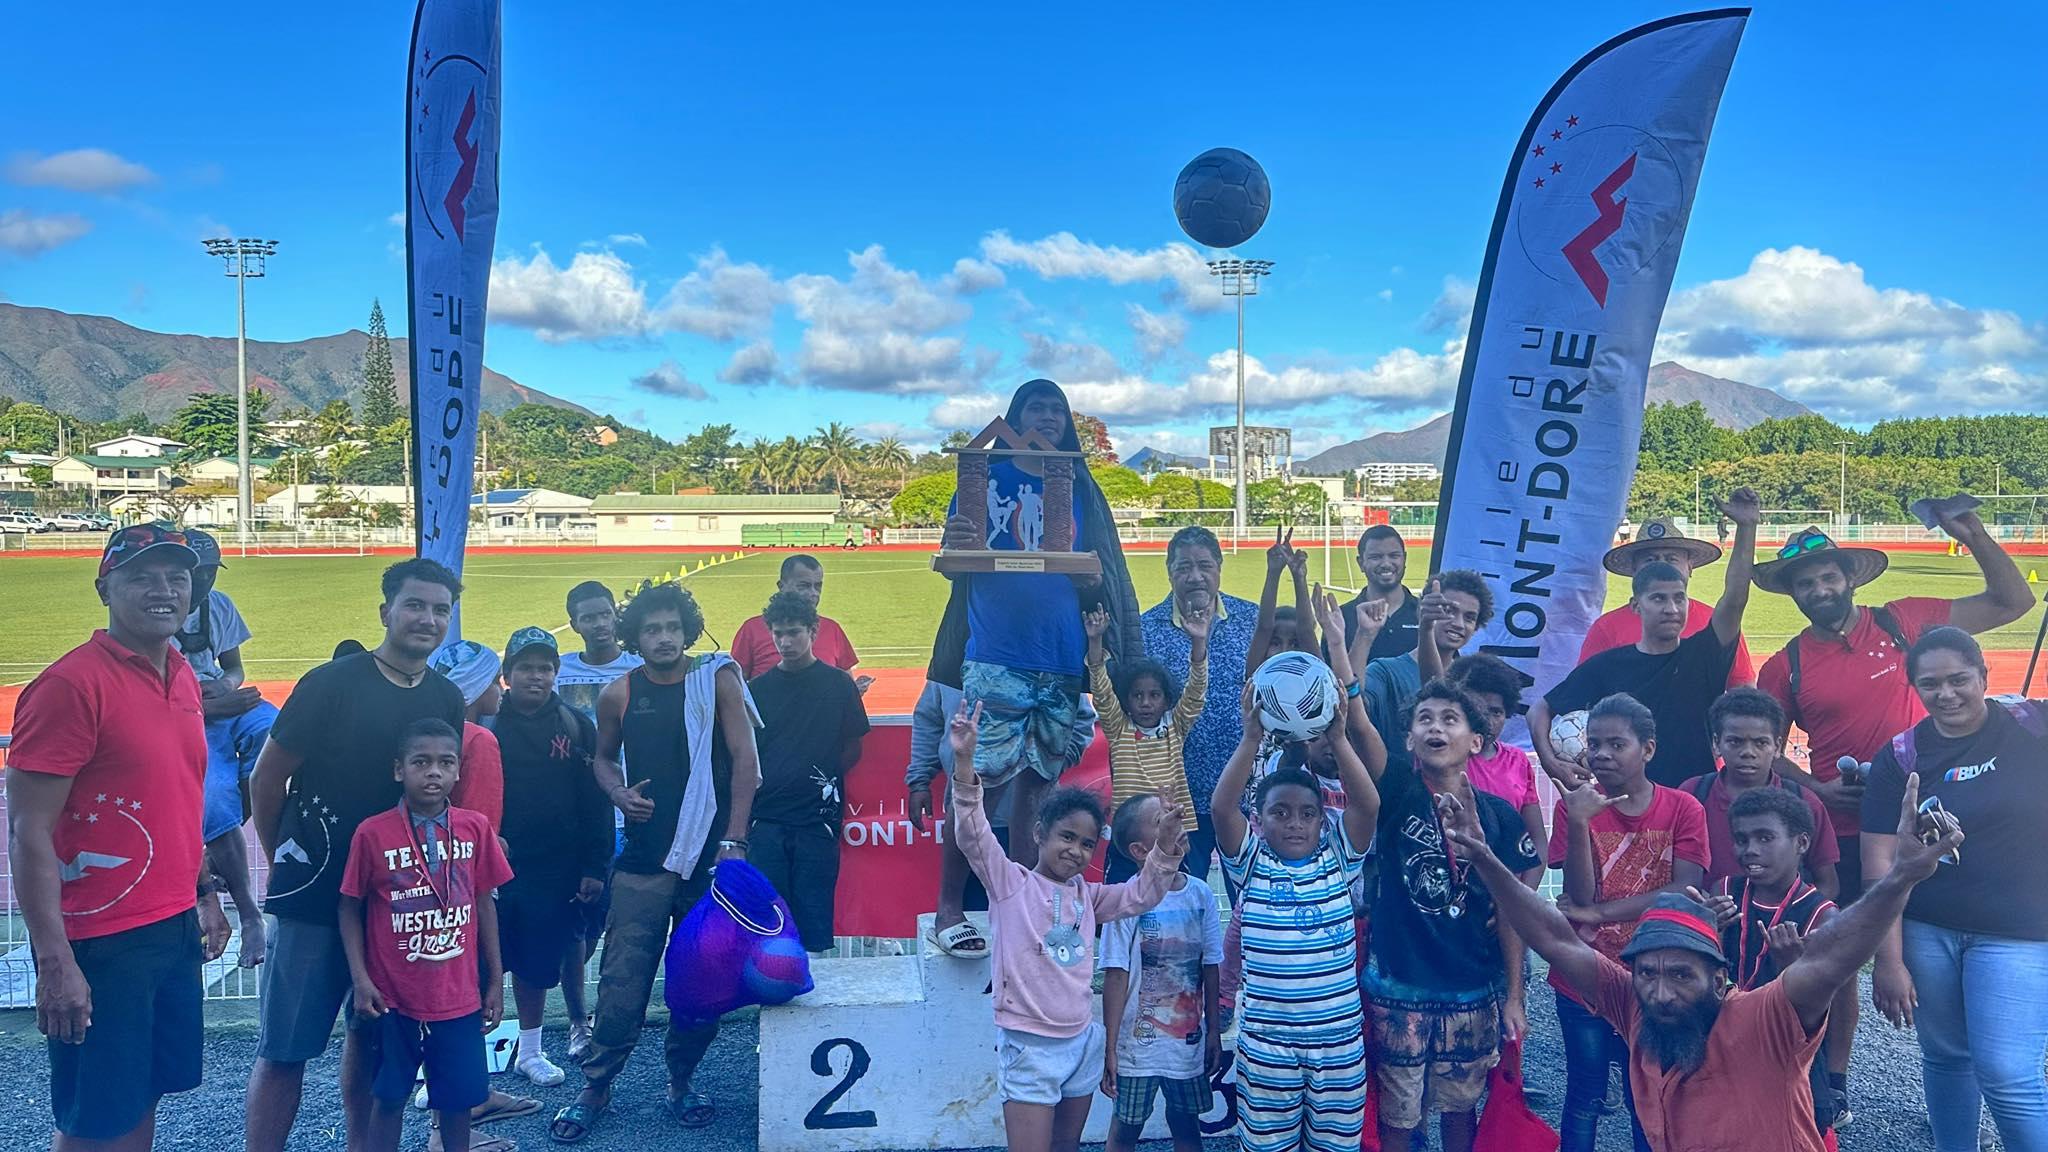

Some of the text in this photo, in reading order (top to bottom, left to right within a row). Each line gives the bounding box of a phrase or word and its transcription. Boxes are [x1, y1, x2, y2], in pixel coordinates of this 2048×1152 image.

[1508, 327, 1544, 398] du
[549, 734, 571, 760] NY
[848, 798, 945, 816] vil
[949, 929, 978, 942] PUMA
[803, 1037, 878, 1130] 2
